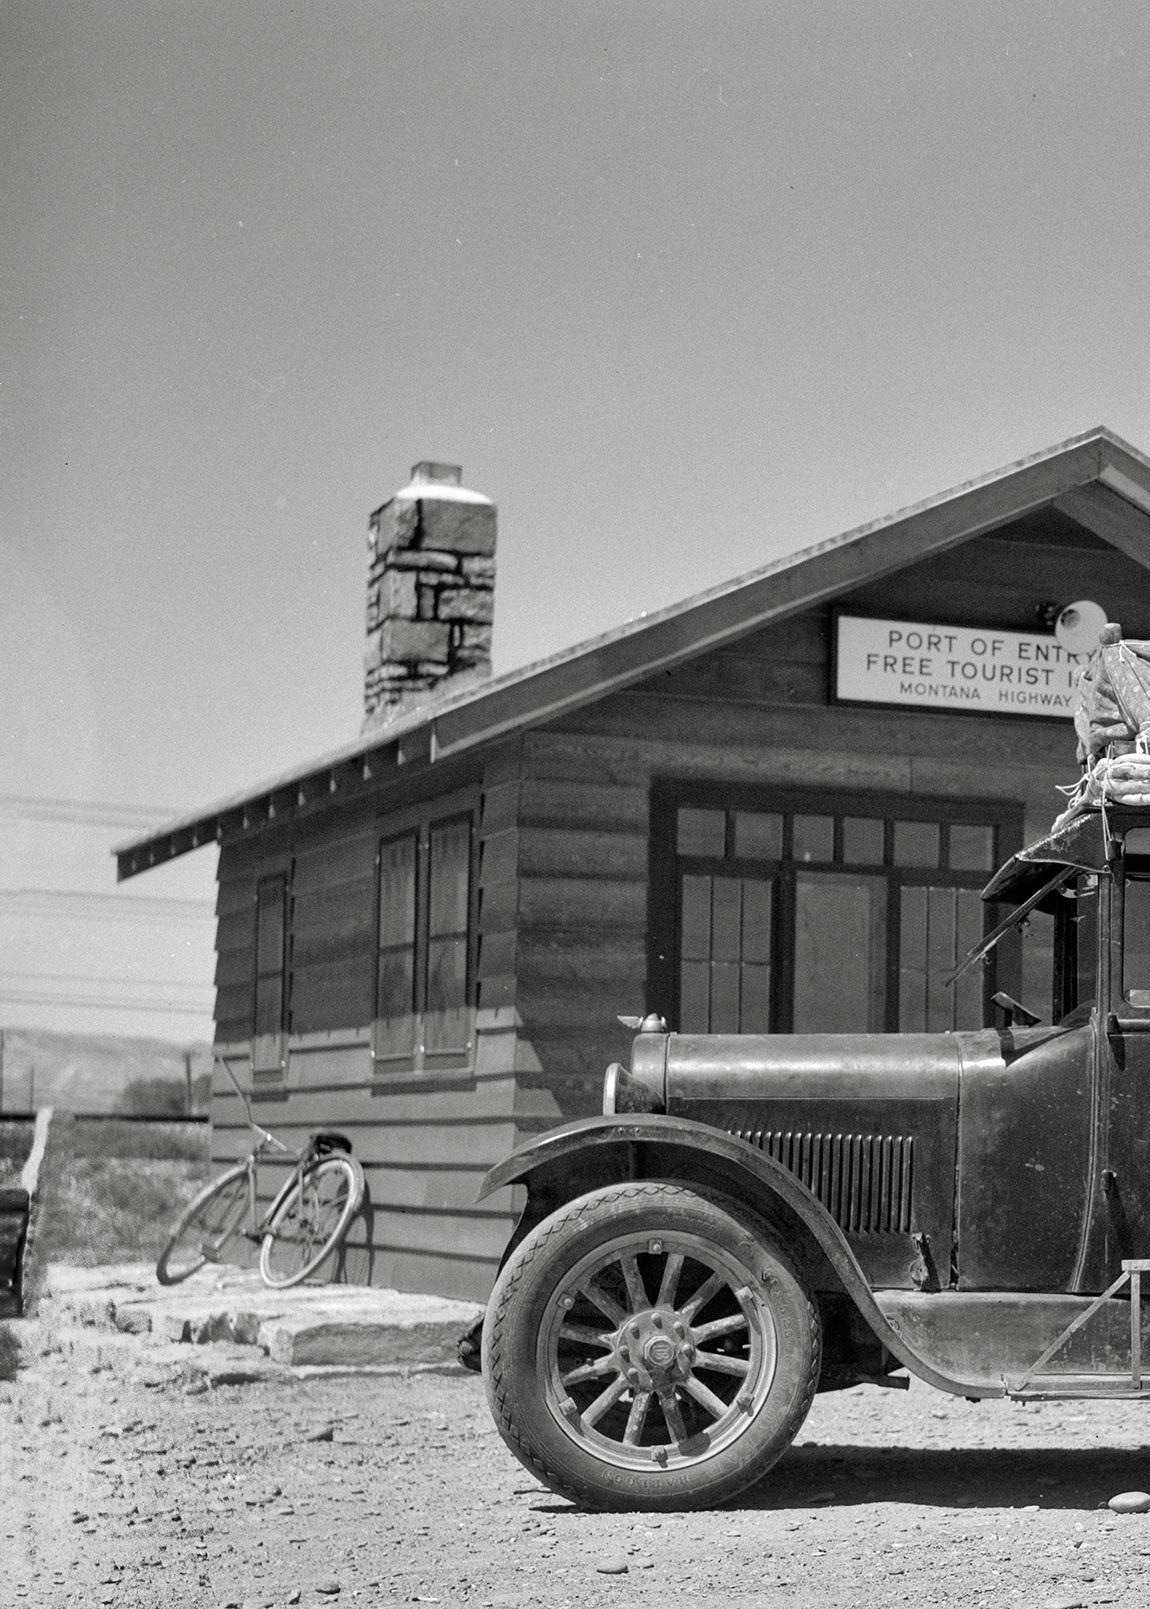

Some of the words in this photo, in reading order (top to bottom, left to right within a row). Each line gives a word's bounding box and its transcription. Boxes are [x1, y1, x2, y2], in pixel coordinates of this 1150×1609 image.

[888, 630, 958, 653] PORT
[970, 638, 1005, 657] OF
[866, 653, 933, 676] FREE
[947, 660, 1054, 686] TOURIST
[899, 681, 981, 700] MONTANA
[998, 690, 1072, 707] HIGHWAY
